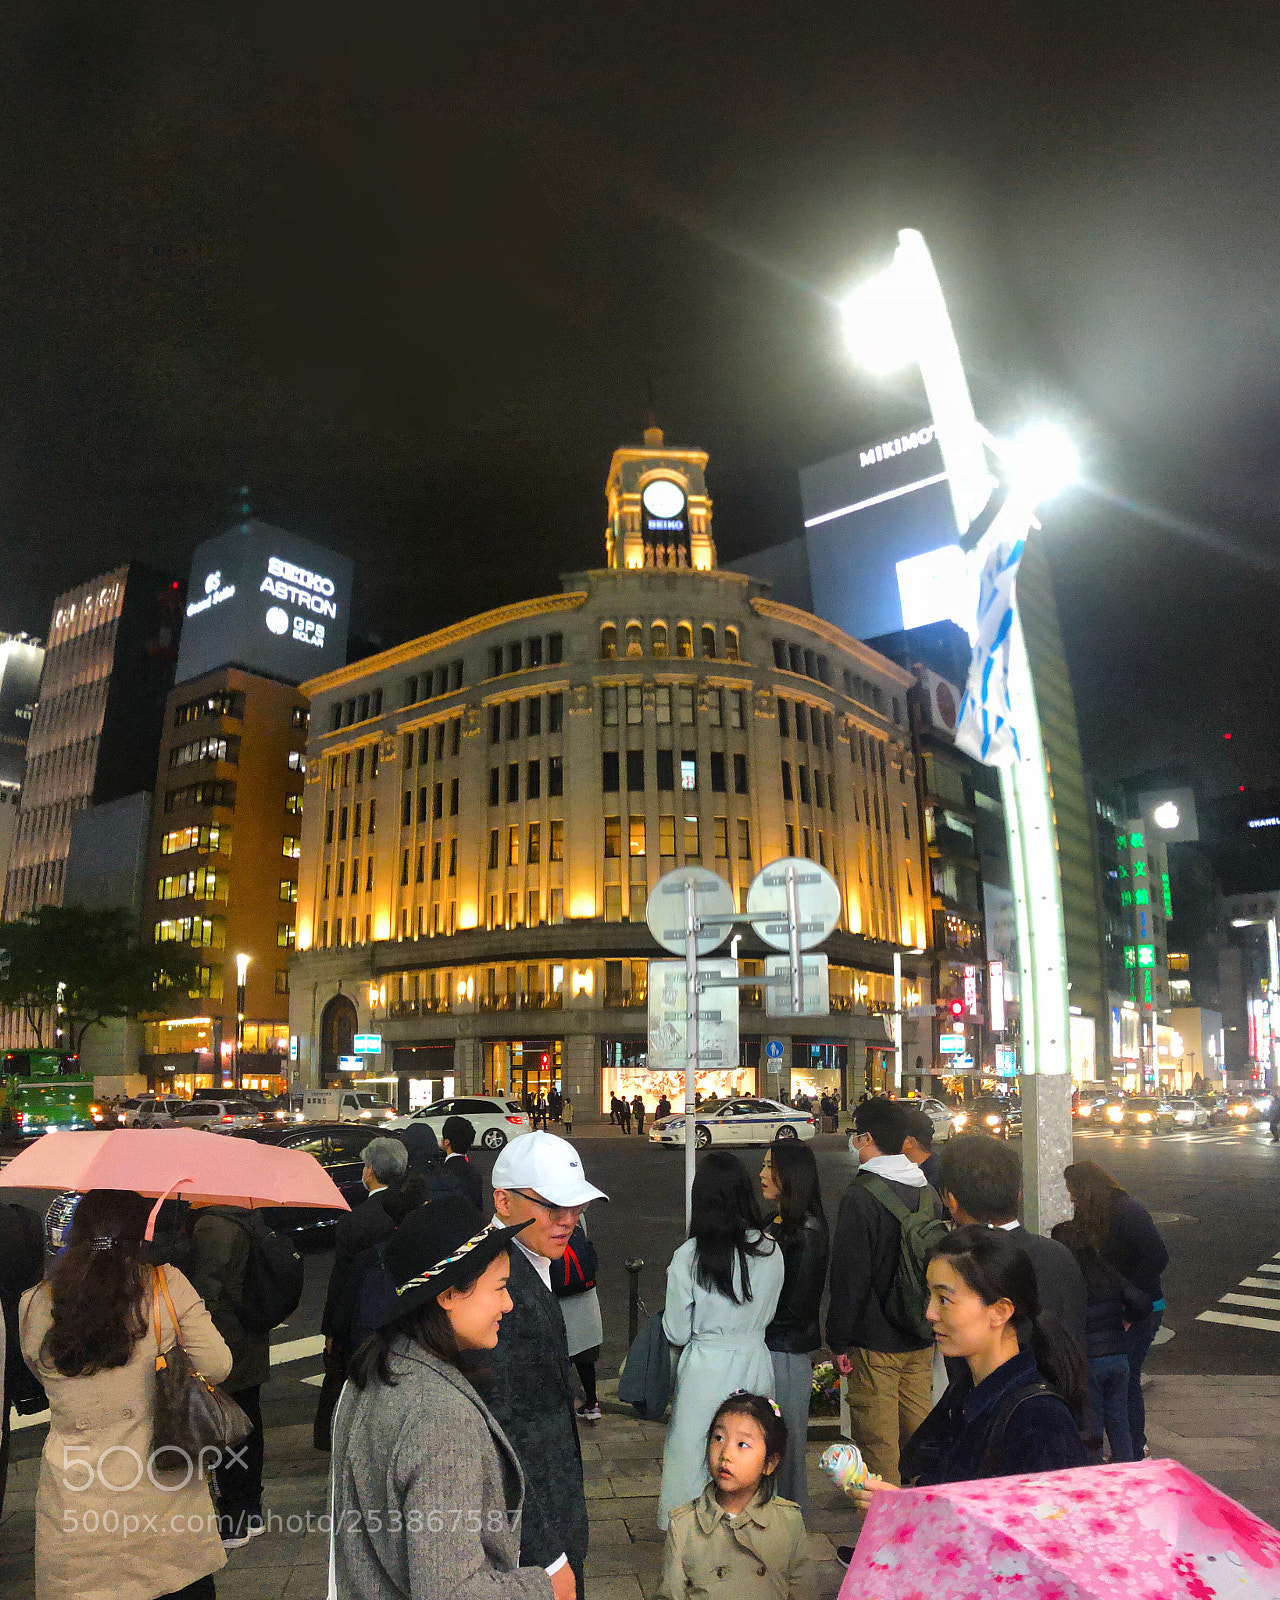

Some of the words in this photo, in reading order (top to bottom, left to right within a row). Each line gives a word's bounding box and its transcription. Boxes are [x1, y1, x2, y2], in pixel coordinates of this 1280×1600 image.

[648, 519, 684, 531] SEIKO
[268, 556, 335, 597] SEIKO
[260, 576, 337, 619] ASTRON
[293, 616, 326, 639] GPS
[293, 629, 325, 648] SOLAR
[1248, 816, 1280, 829] CHANEL
